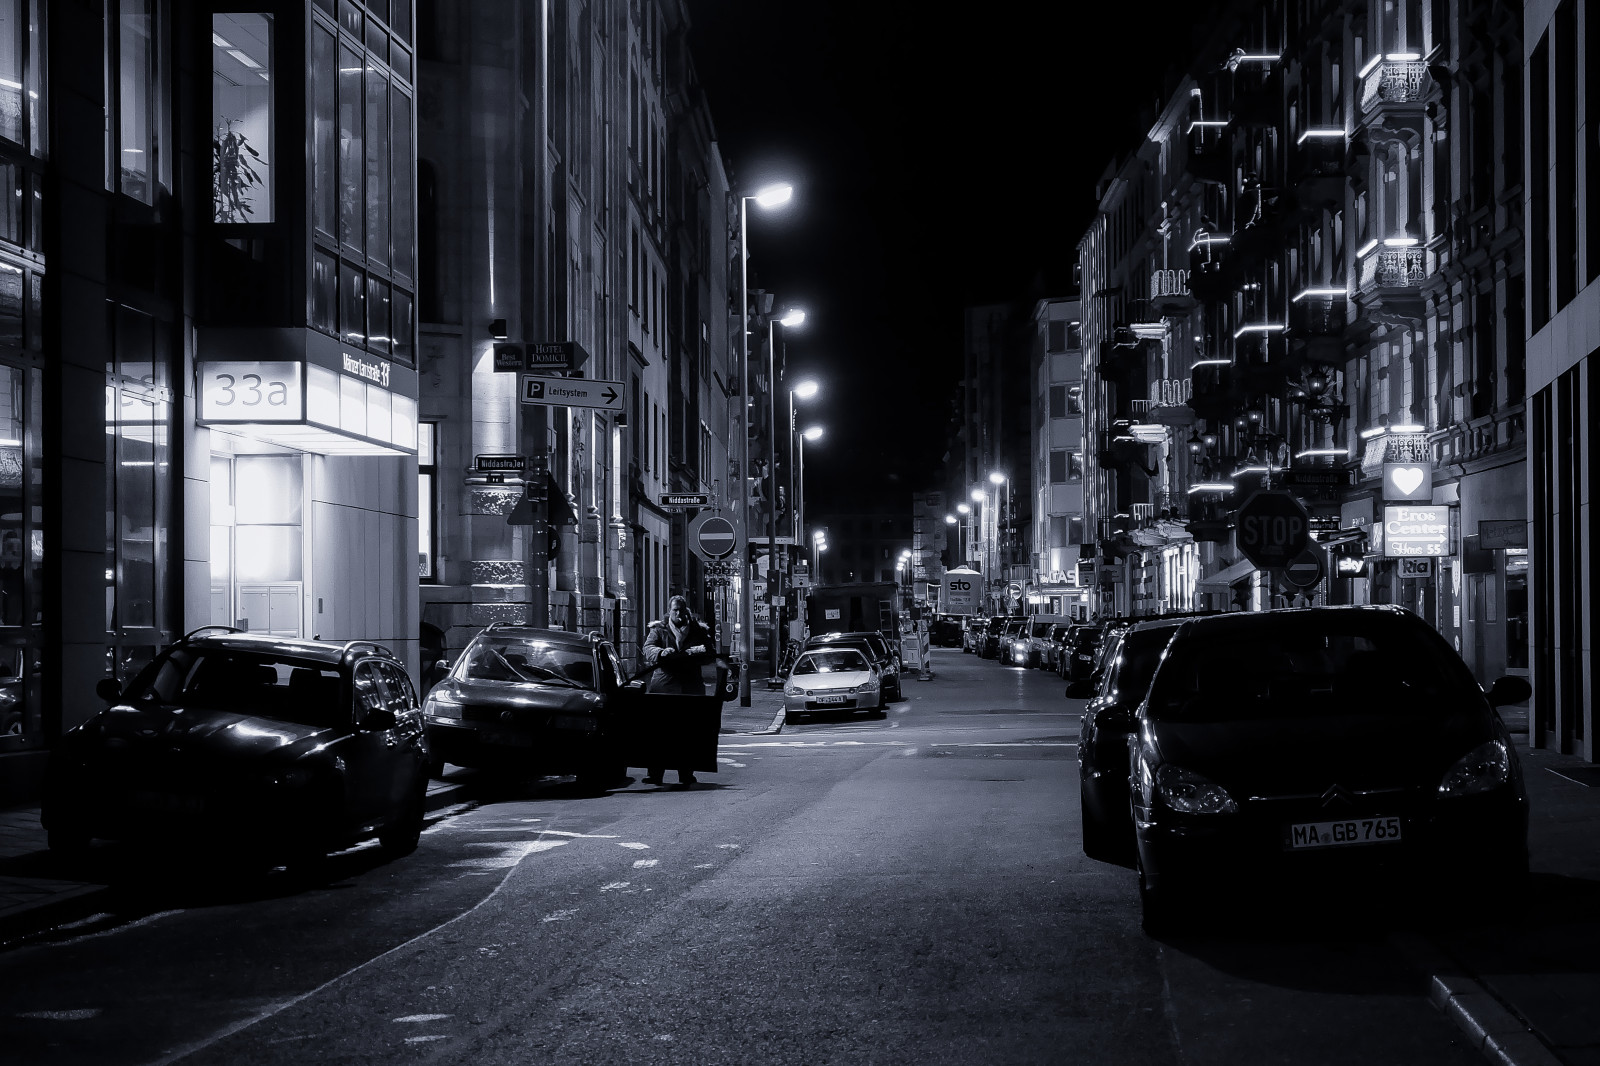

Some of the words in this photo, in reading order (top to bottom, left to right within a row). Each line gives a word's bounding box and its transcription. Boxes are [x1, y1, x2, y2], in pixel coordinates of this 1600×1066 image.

[535, 344, 564, 353] HOTEL
[501, 353, 516, 361] Best
[532, 353, 568, 362] DOMICIL
[215, 373, 288, 406] 33a
[530, 383, 541, 397] P
[548, 386, 588, 398] Leitsystem
[668, 496, 701, 504] Niddastraße
[1396, 507, 1436, 522] Eros
[1243, 515, 1303, 546] STOP
[1386, 521, 1448, 535] Center
[1426, 543, 1442, 555] 55
[1338, 557, 1364, 573] sky
[1402, 559, 1429, 574] Ria
[949, 578, 971, 591] sto
[1293, 825, 1320, 845] MA
[1332, 822, 1359, 842] GB
[1361, 818, 1399, 840] 765
